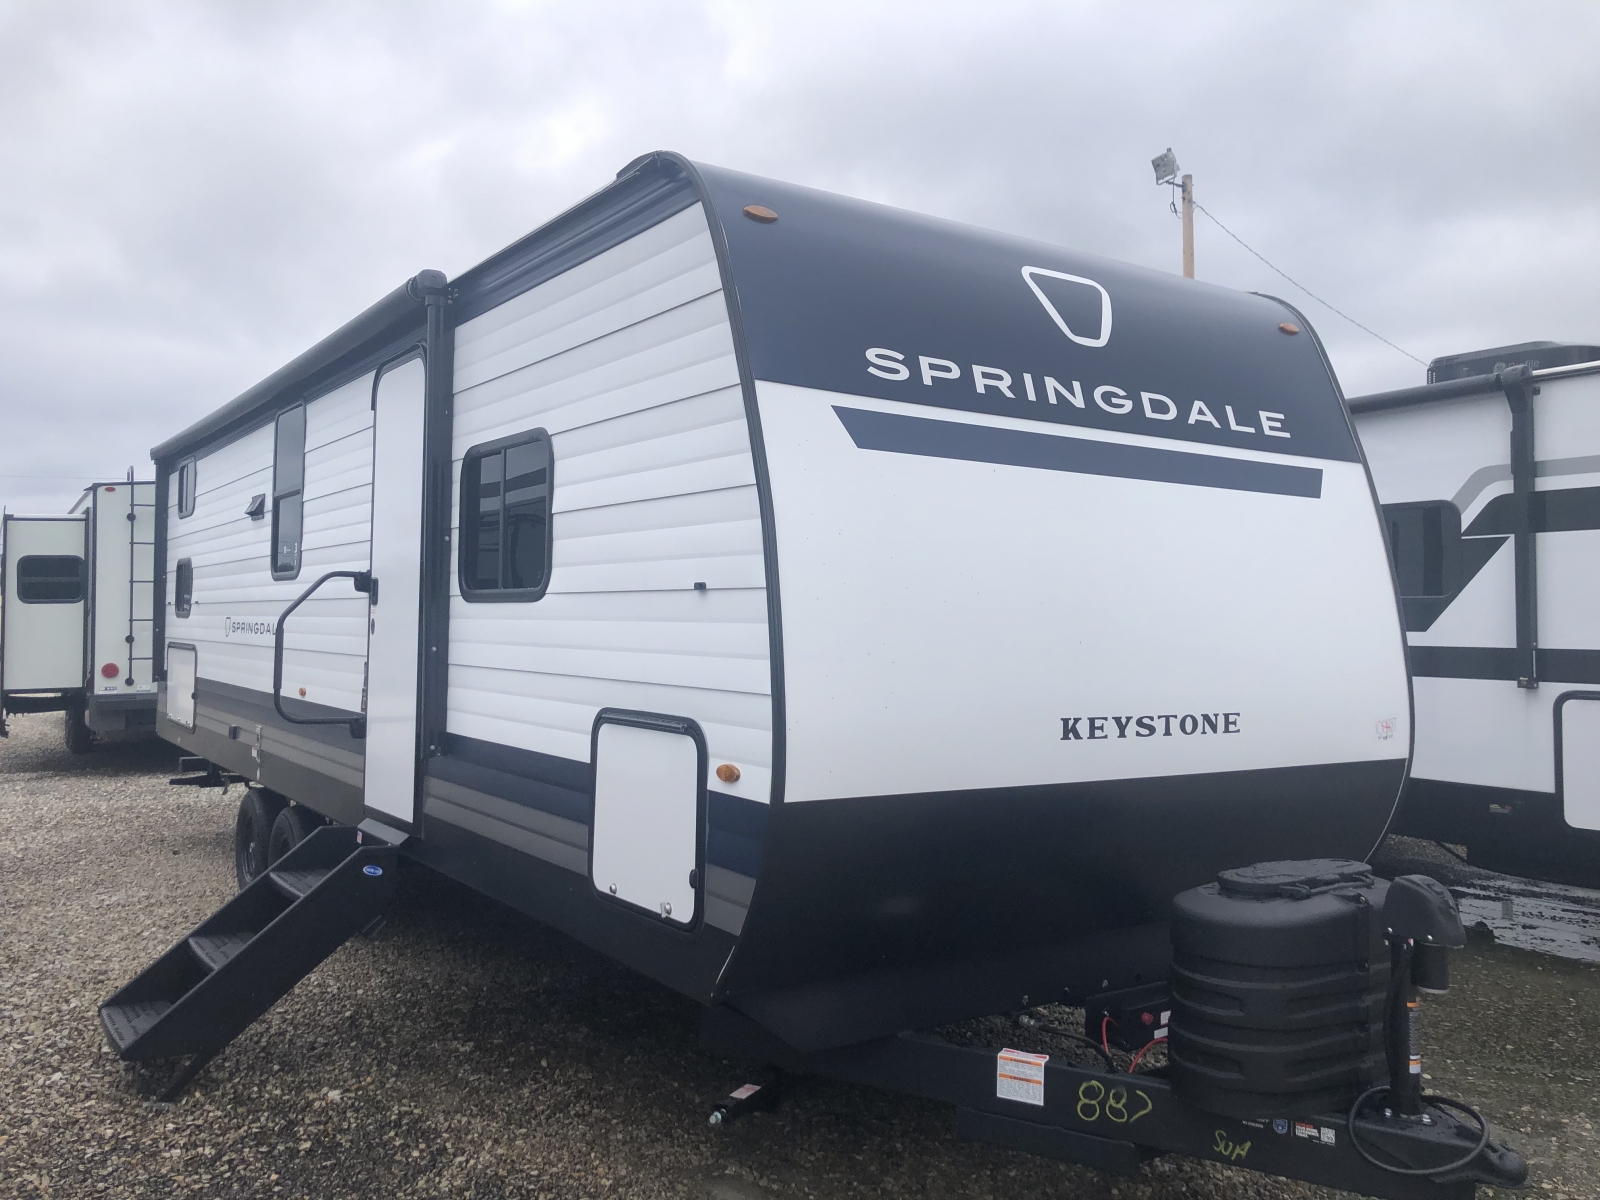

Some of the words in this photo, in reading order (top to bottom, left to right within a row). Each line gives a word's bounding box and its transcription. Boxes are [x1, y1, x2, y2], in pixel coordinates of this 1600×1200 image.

[865, 347, 1291, 439] SPRINGDALE
[231, 621, 277, 636] SPRINGDAL
[1060, 712, 1241, 741] KEYSTONE
